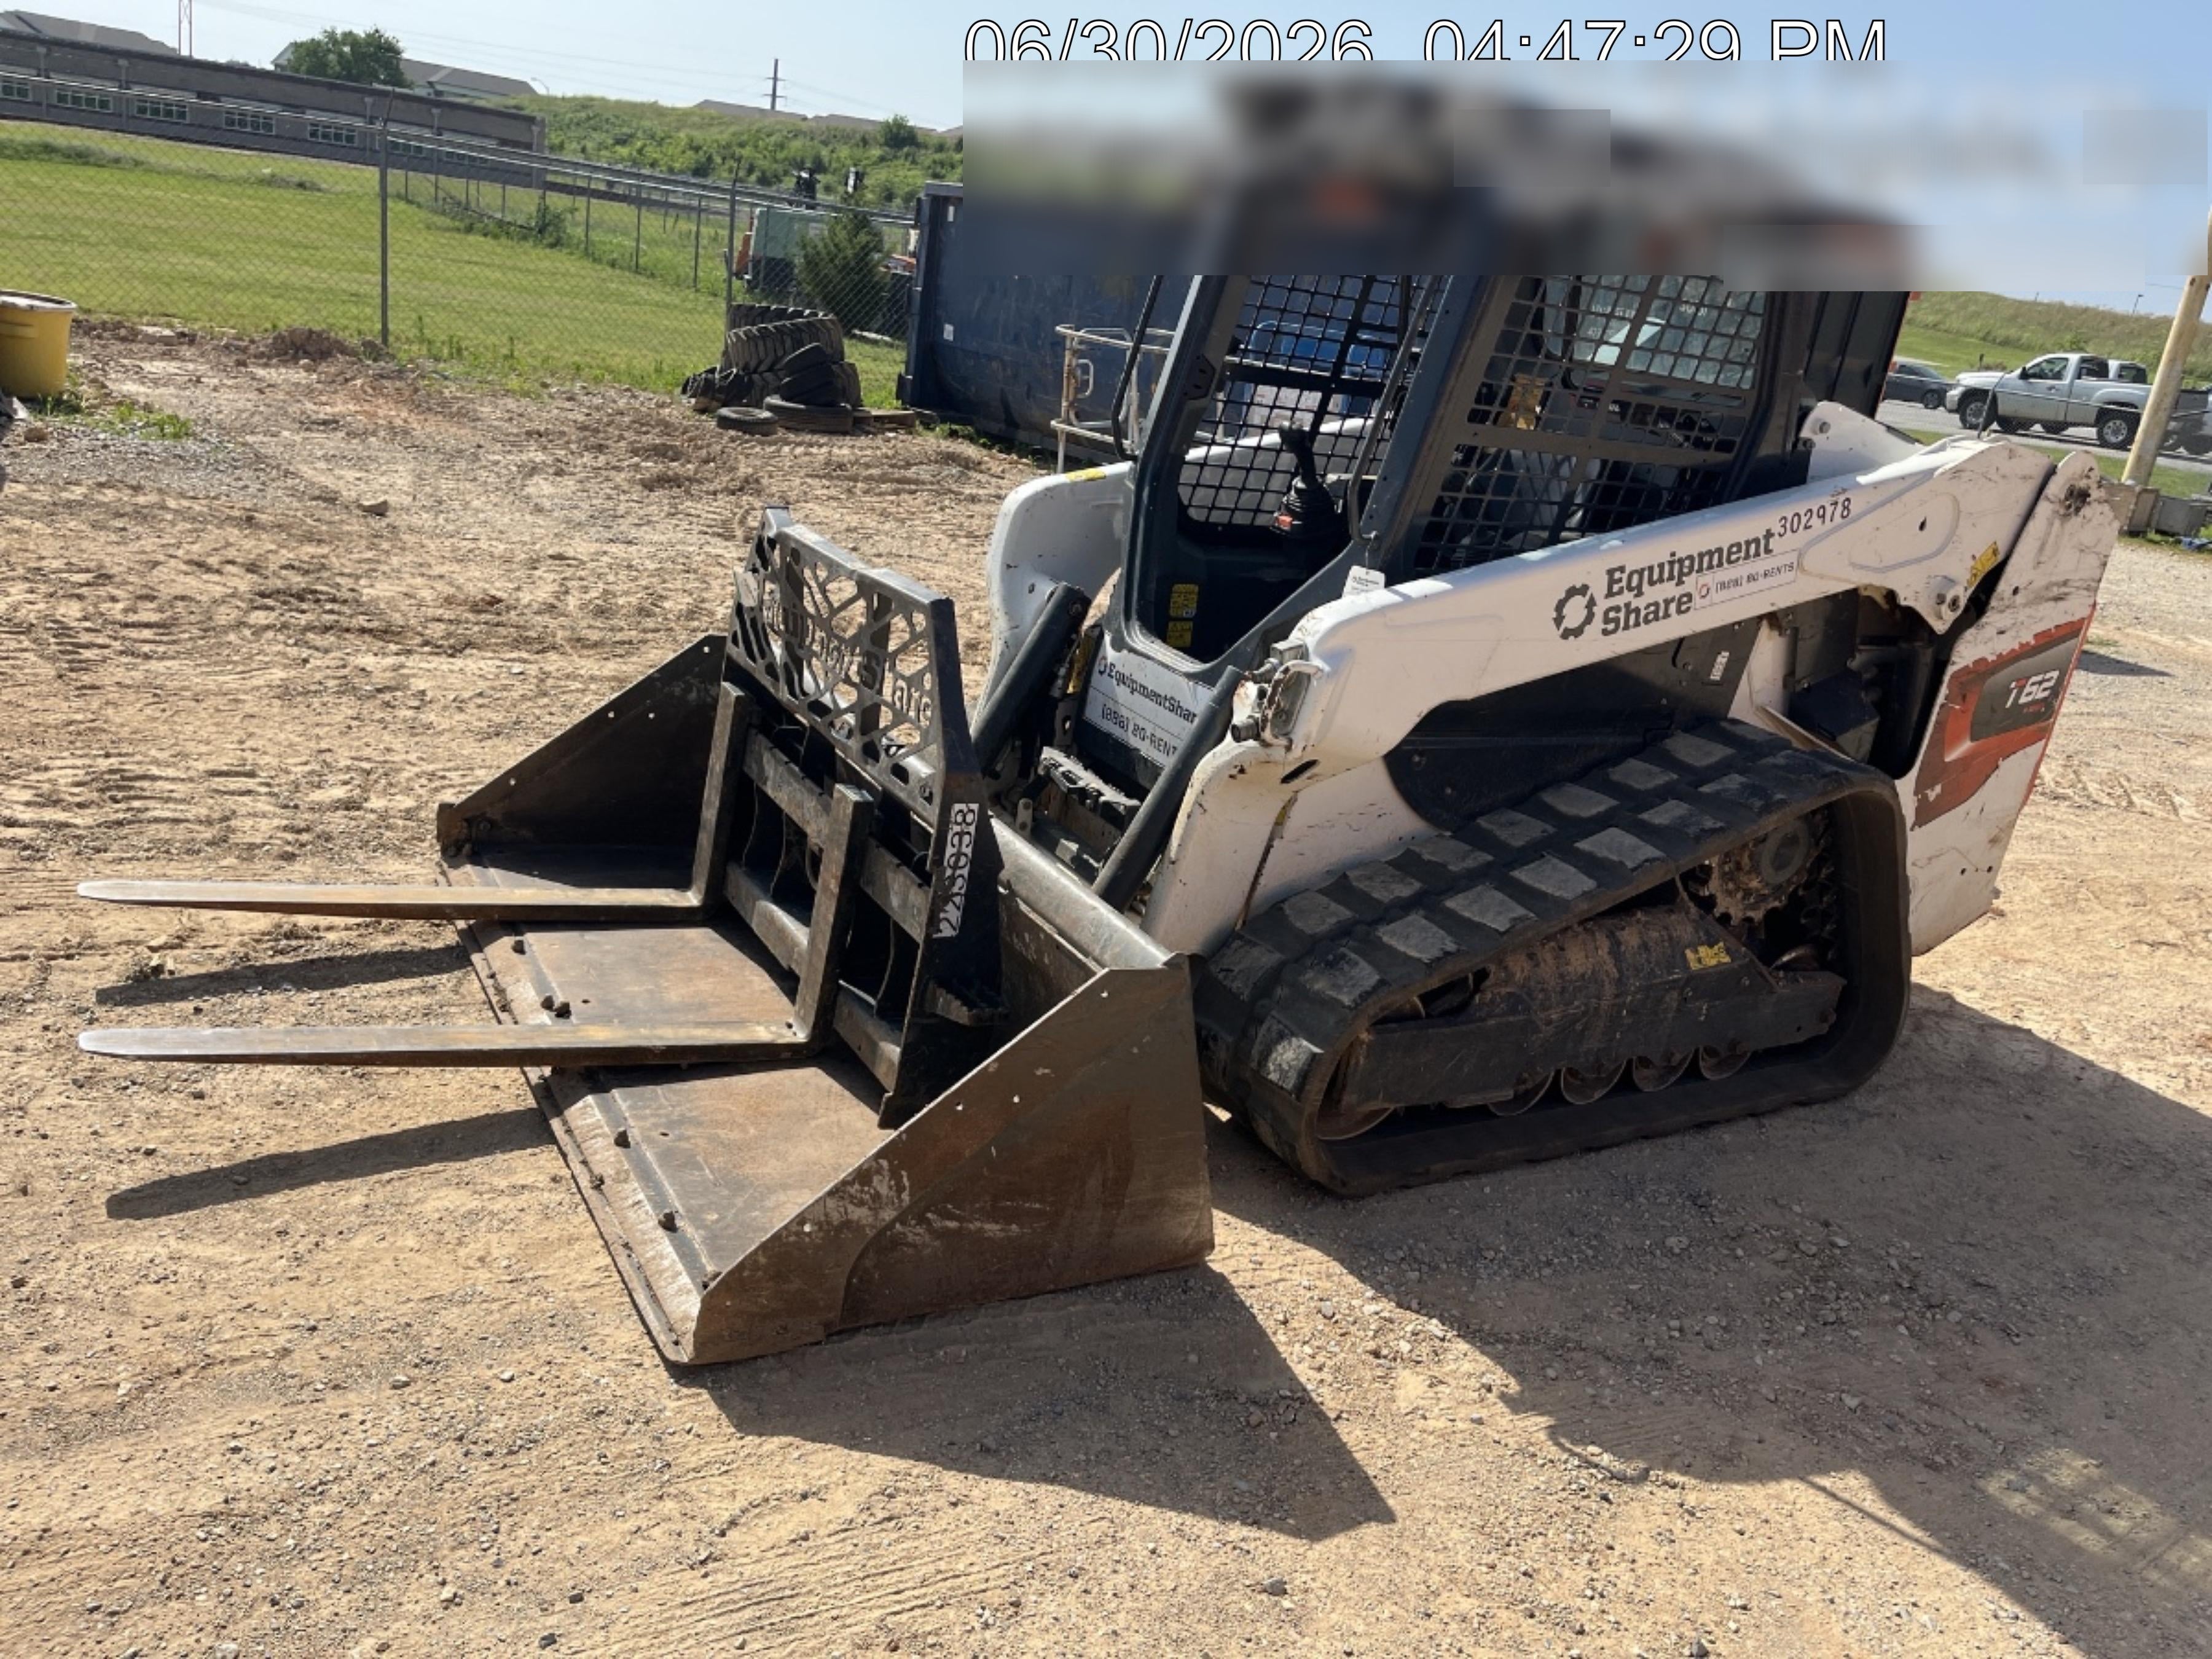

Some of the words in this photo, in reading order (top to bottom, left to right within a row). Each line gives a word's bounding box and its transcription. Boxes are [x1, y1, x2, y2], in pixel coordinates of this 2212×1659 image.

[1778, 497, 1851, 537] 302978
[1604, 528, 1775, 600] Equipment
[1601, 592, 1693, 637] Share
[1107, 663, 1197, 724] EquipmentShar
